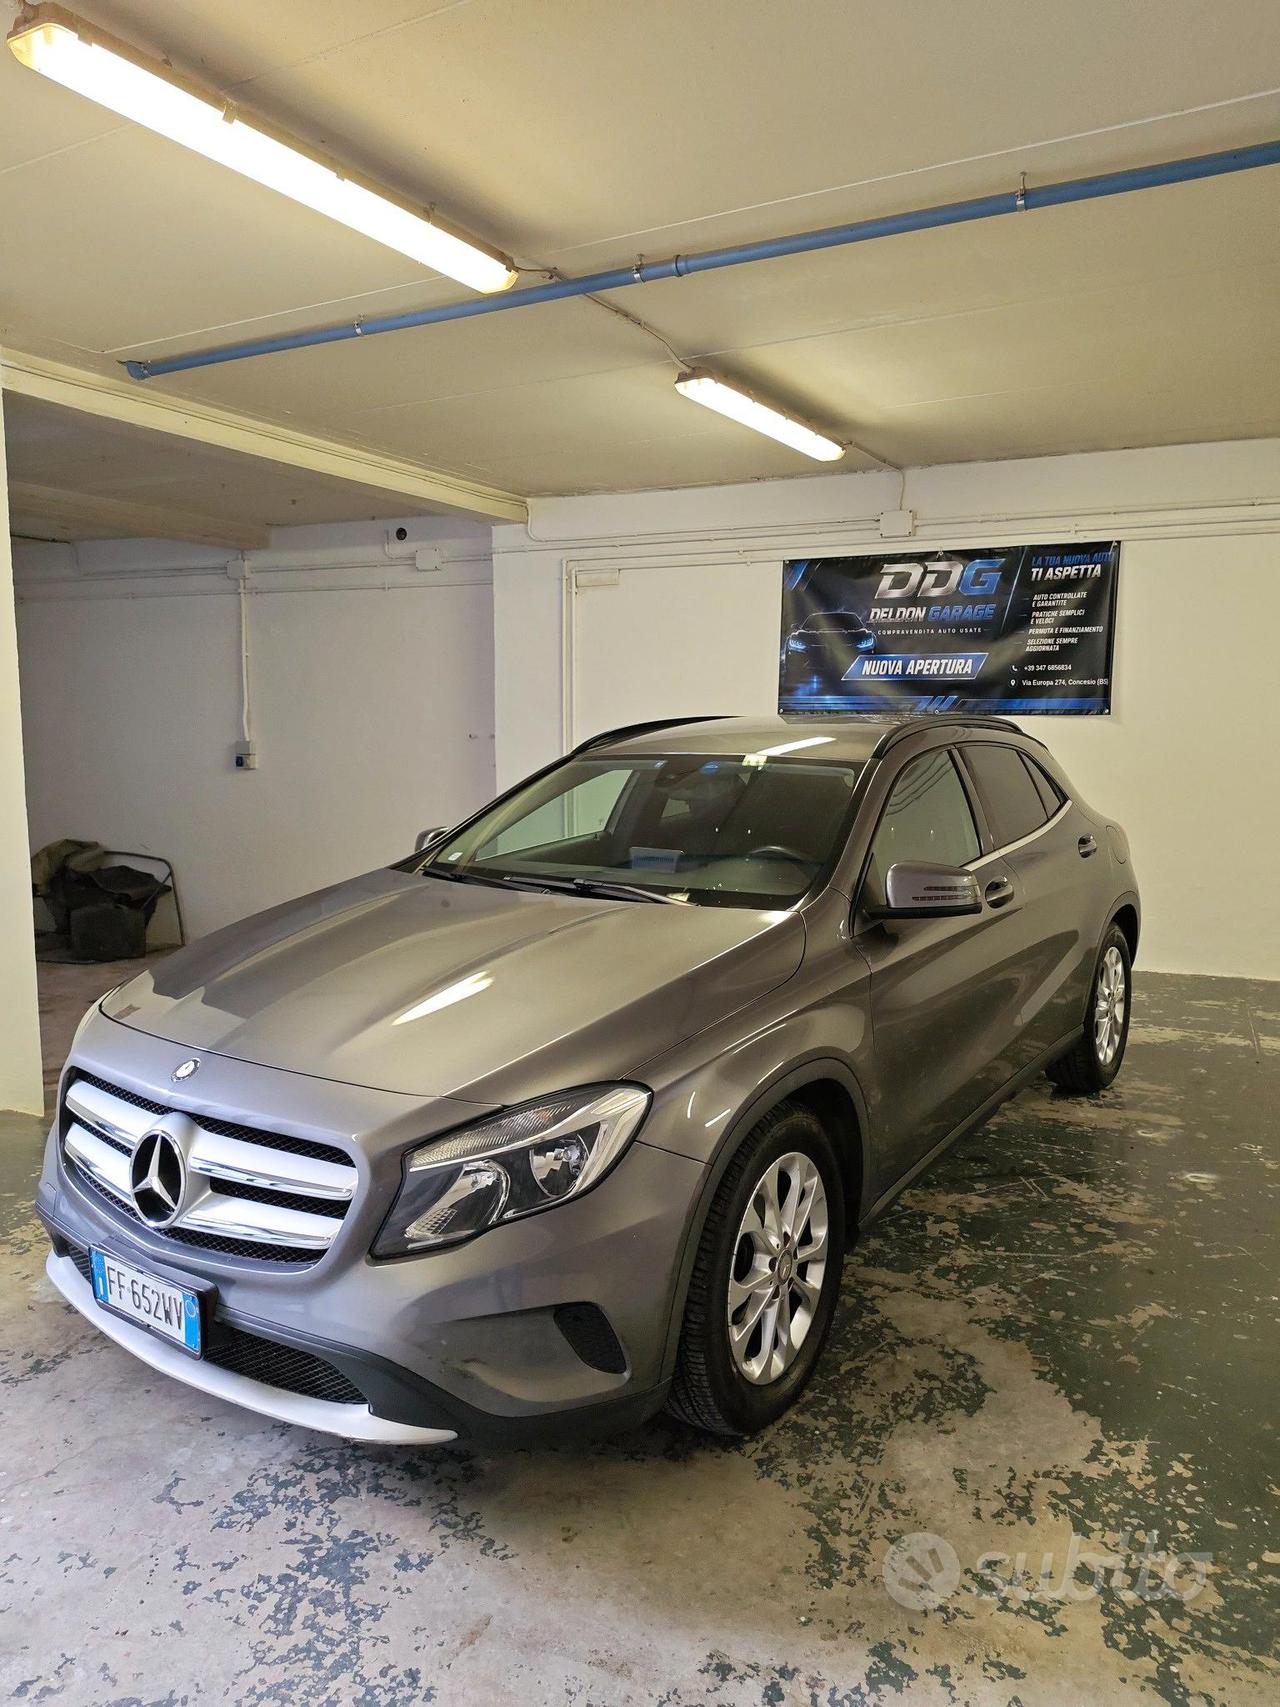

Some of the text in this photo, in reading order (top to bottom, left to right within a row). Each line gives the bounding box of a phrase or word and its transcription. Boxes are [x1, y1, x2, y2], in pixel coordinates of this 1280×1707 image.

[1032, 552, 1115, 566] LA TUA NUOVA AUTO
[874, 558, 1006, 599] DDG
[1031, 565, 1101, 581] TI ASPETTA
[1049, 592, 1087, 600] CONTROLLATE
[869, 604, 996, 622] DELDON GARAGE
[1058, 609, 1085, 617] SEMPLICI
[862, 659, 973, 675] NUOVA APERTURA
[1032, 679, 1054, 687] Europa
[1054, 679, 1067, 687] 274,
[107, 1266, 126, 1300] FF
